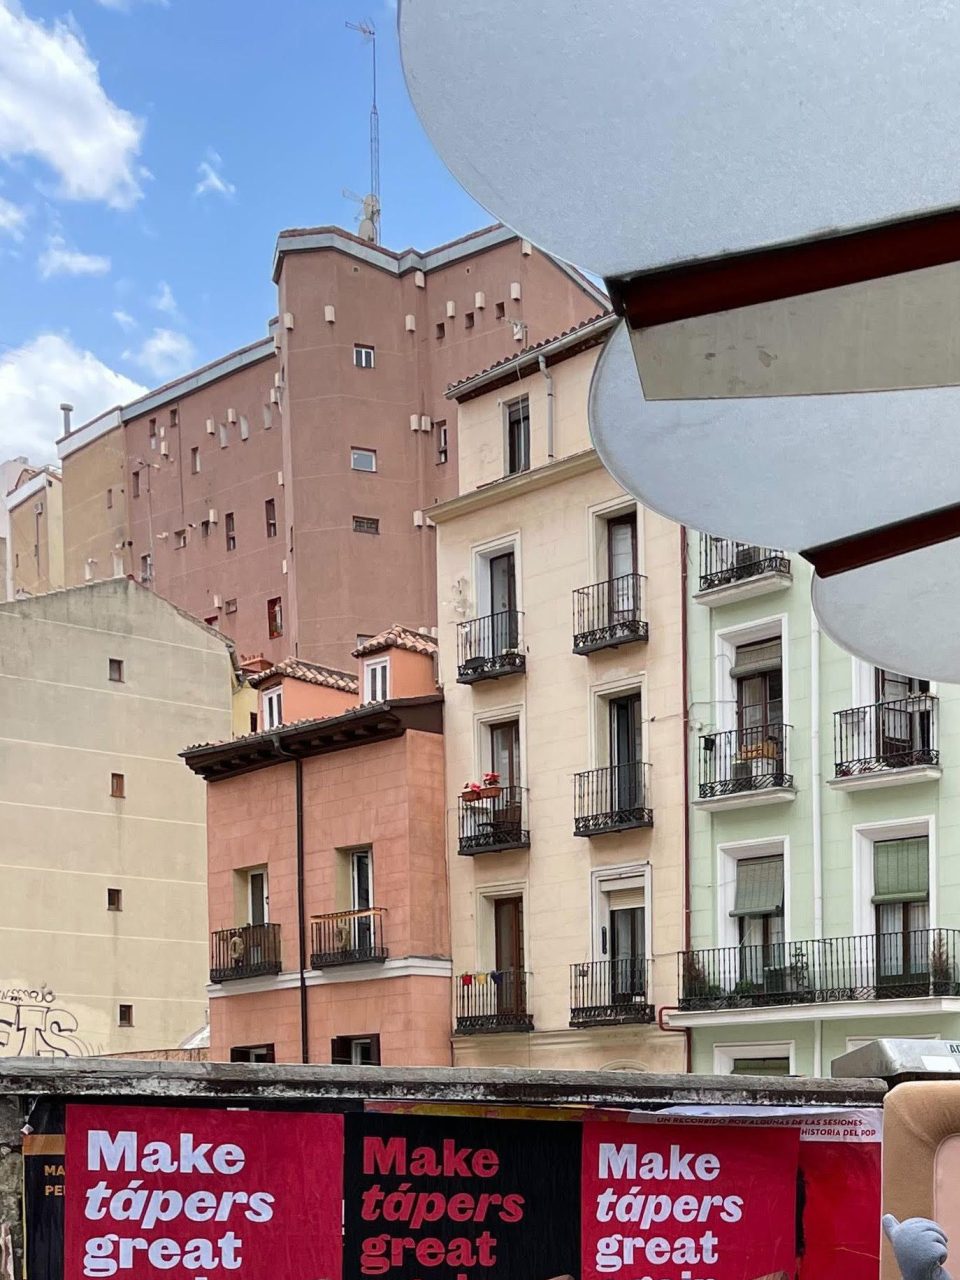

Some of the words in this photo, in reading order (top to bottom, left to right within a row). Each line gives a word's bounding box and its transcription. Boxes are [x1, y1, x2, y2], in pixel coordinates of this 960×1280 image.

[672, 1117, 726, 1125] RECORRIDO
[801, 1128, 841, 1137] HISTORIA
[843, 1128, 859, 1137] DEL
[861, 1129, 876, 1137] POP
[87, 1130, 246, 1175] Make
[362, 1136, 500, 1177] Make
[597, 1143, 720, 1180] Make
[44, 1185, 65, 1196] PE
[83, 1180, 276, 1229] tápers
[360, 1184, 525, 1229] tápers
[596, 1187, 744, 1230] tápers
[83, 1231, 243, 1278] great
[360, 1231, 497, 1275] great
[596, 1231, 719, 1273] great
